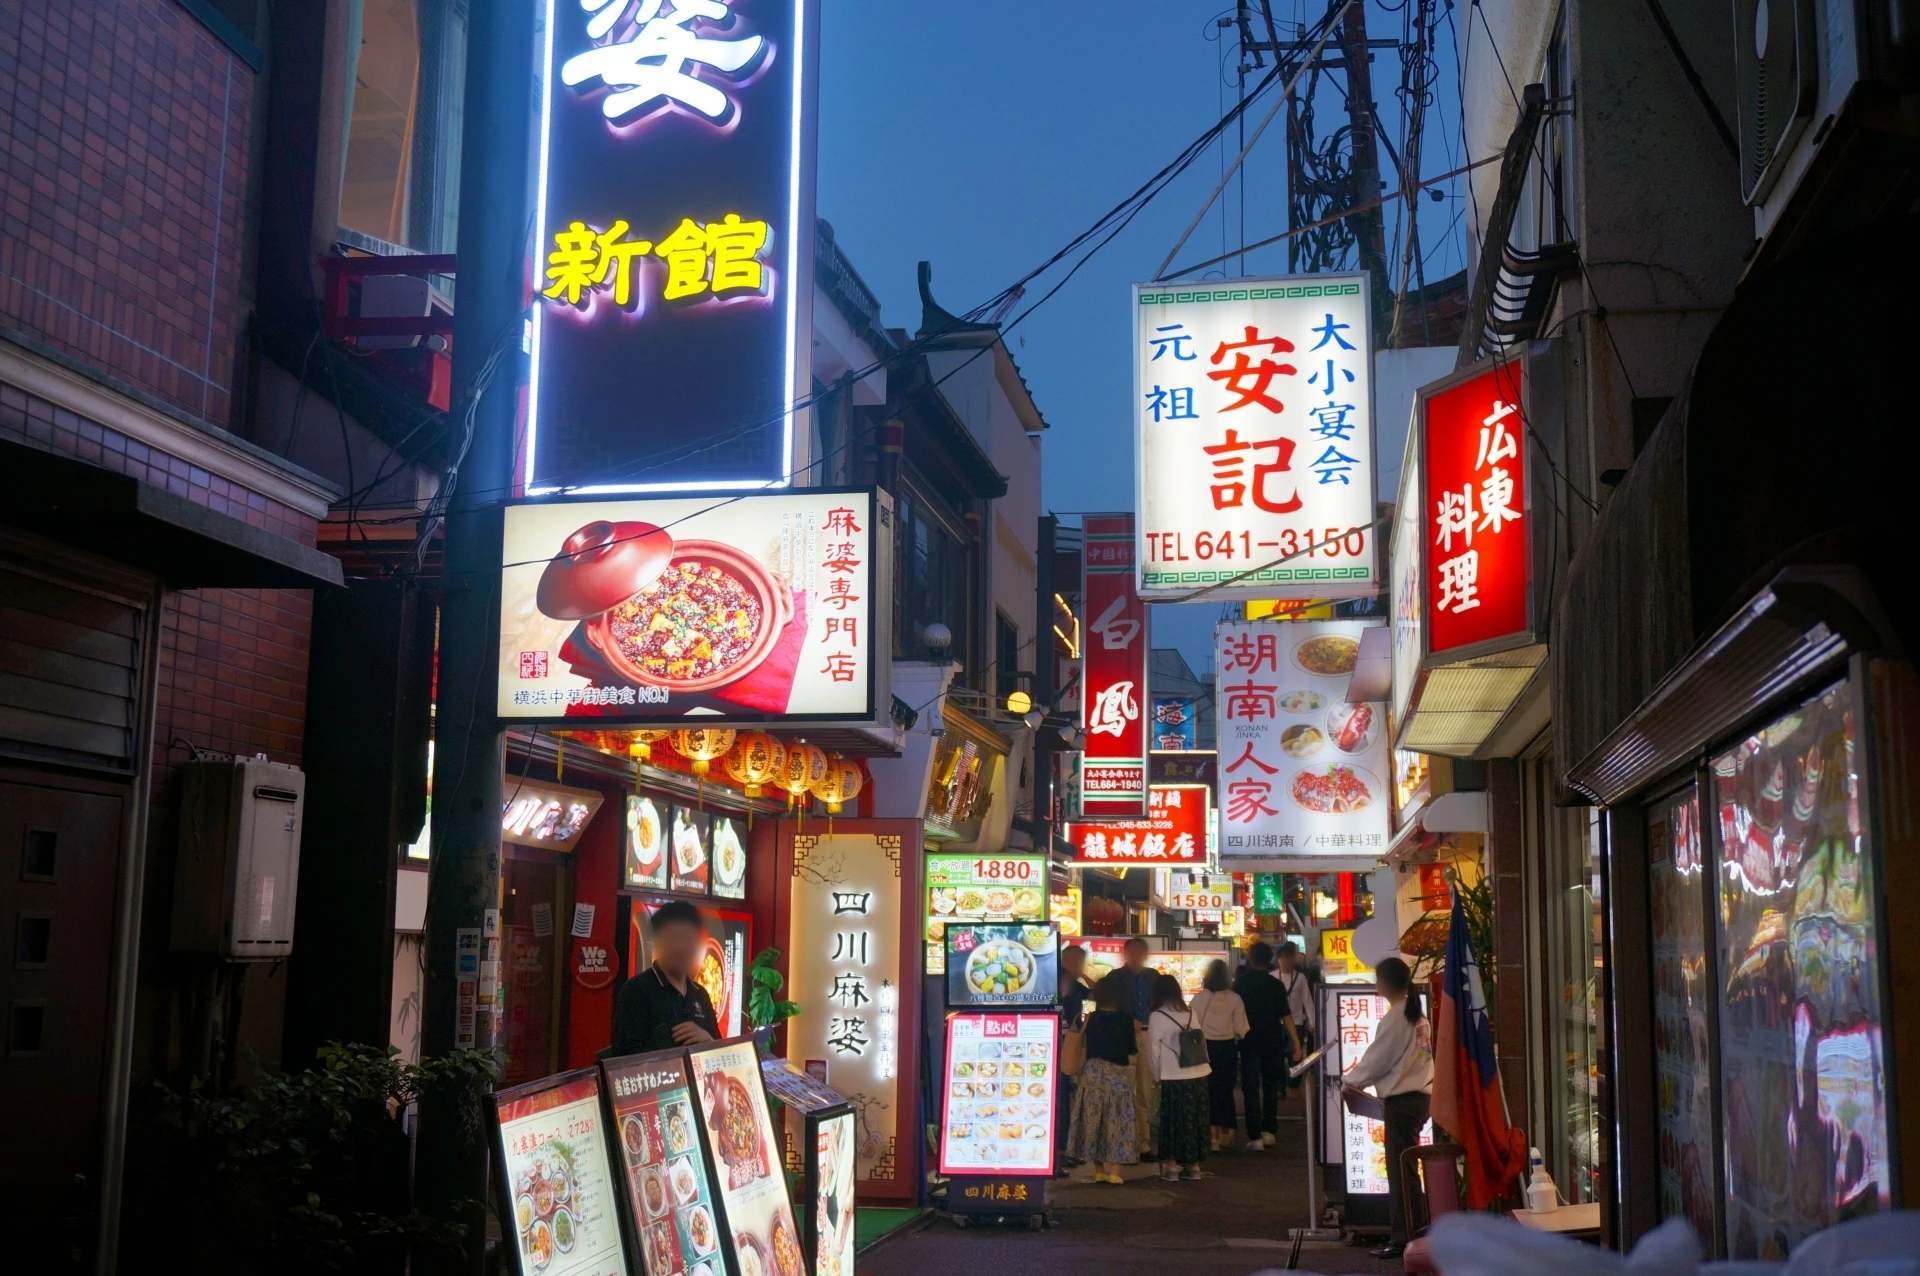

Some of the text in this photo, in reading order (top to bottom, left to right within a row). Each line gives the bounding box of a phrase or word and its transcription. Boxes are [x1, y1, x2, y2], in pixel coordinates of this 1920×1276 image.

[543, 214, 767, 304] 新館
[1145, 323, 1200, 423] 元祖
[1307, 313, 1361, 486] 大小宴会
[1202, 325, 1303, 514] 安記
[1474, 400, 1523, 534] 広東
[1147, 532, 1189, 562] TEL
[1435, 482, 1481, 614] 料理
[820, 506, 863, 683] 麻婆専門店
[1089, 595, 1141, 738] 白鳳
[514, 687, 634, 706] 横浜中華街美食
[1223, 632, 1280, 824] 湖南人家
[1235, 731, 1261, 739] JINKA
[1081, 831, 1195, 859] 龍城飯店
[1228, 834, 1294, 848] 四川湖南
[1316, 833, 1382, 847] 中華料理
[929, 860, 971, 871] 食べ放題
[582, 947, 607, 959] We
[1330, 935, 1347, 955] 順
[828, 892, 872, 1056] 四川麻婆
[985, 1020, 1016, 1035] 點心
[614, 1070, 681, 1098] 当店おすすめメニュー
[965, 1183, 1028, 1201] 四川麻婆
